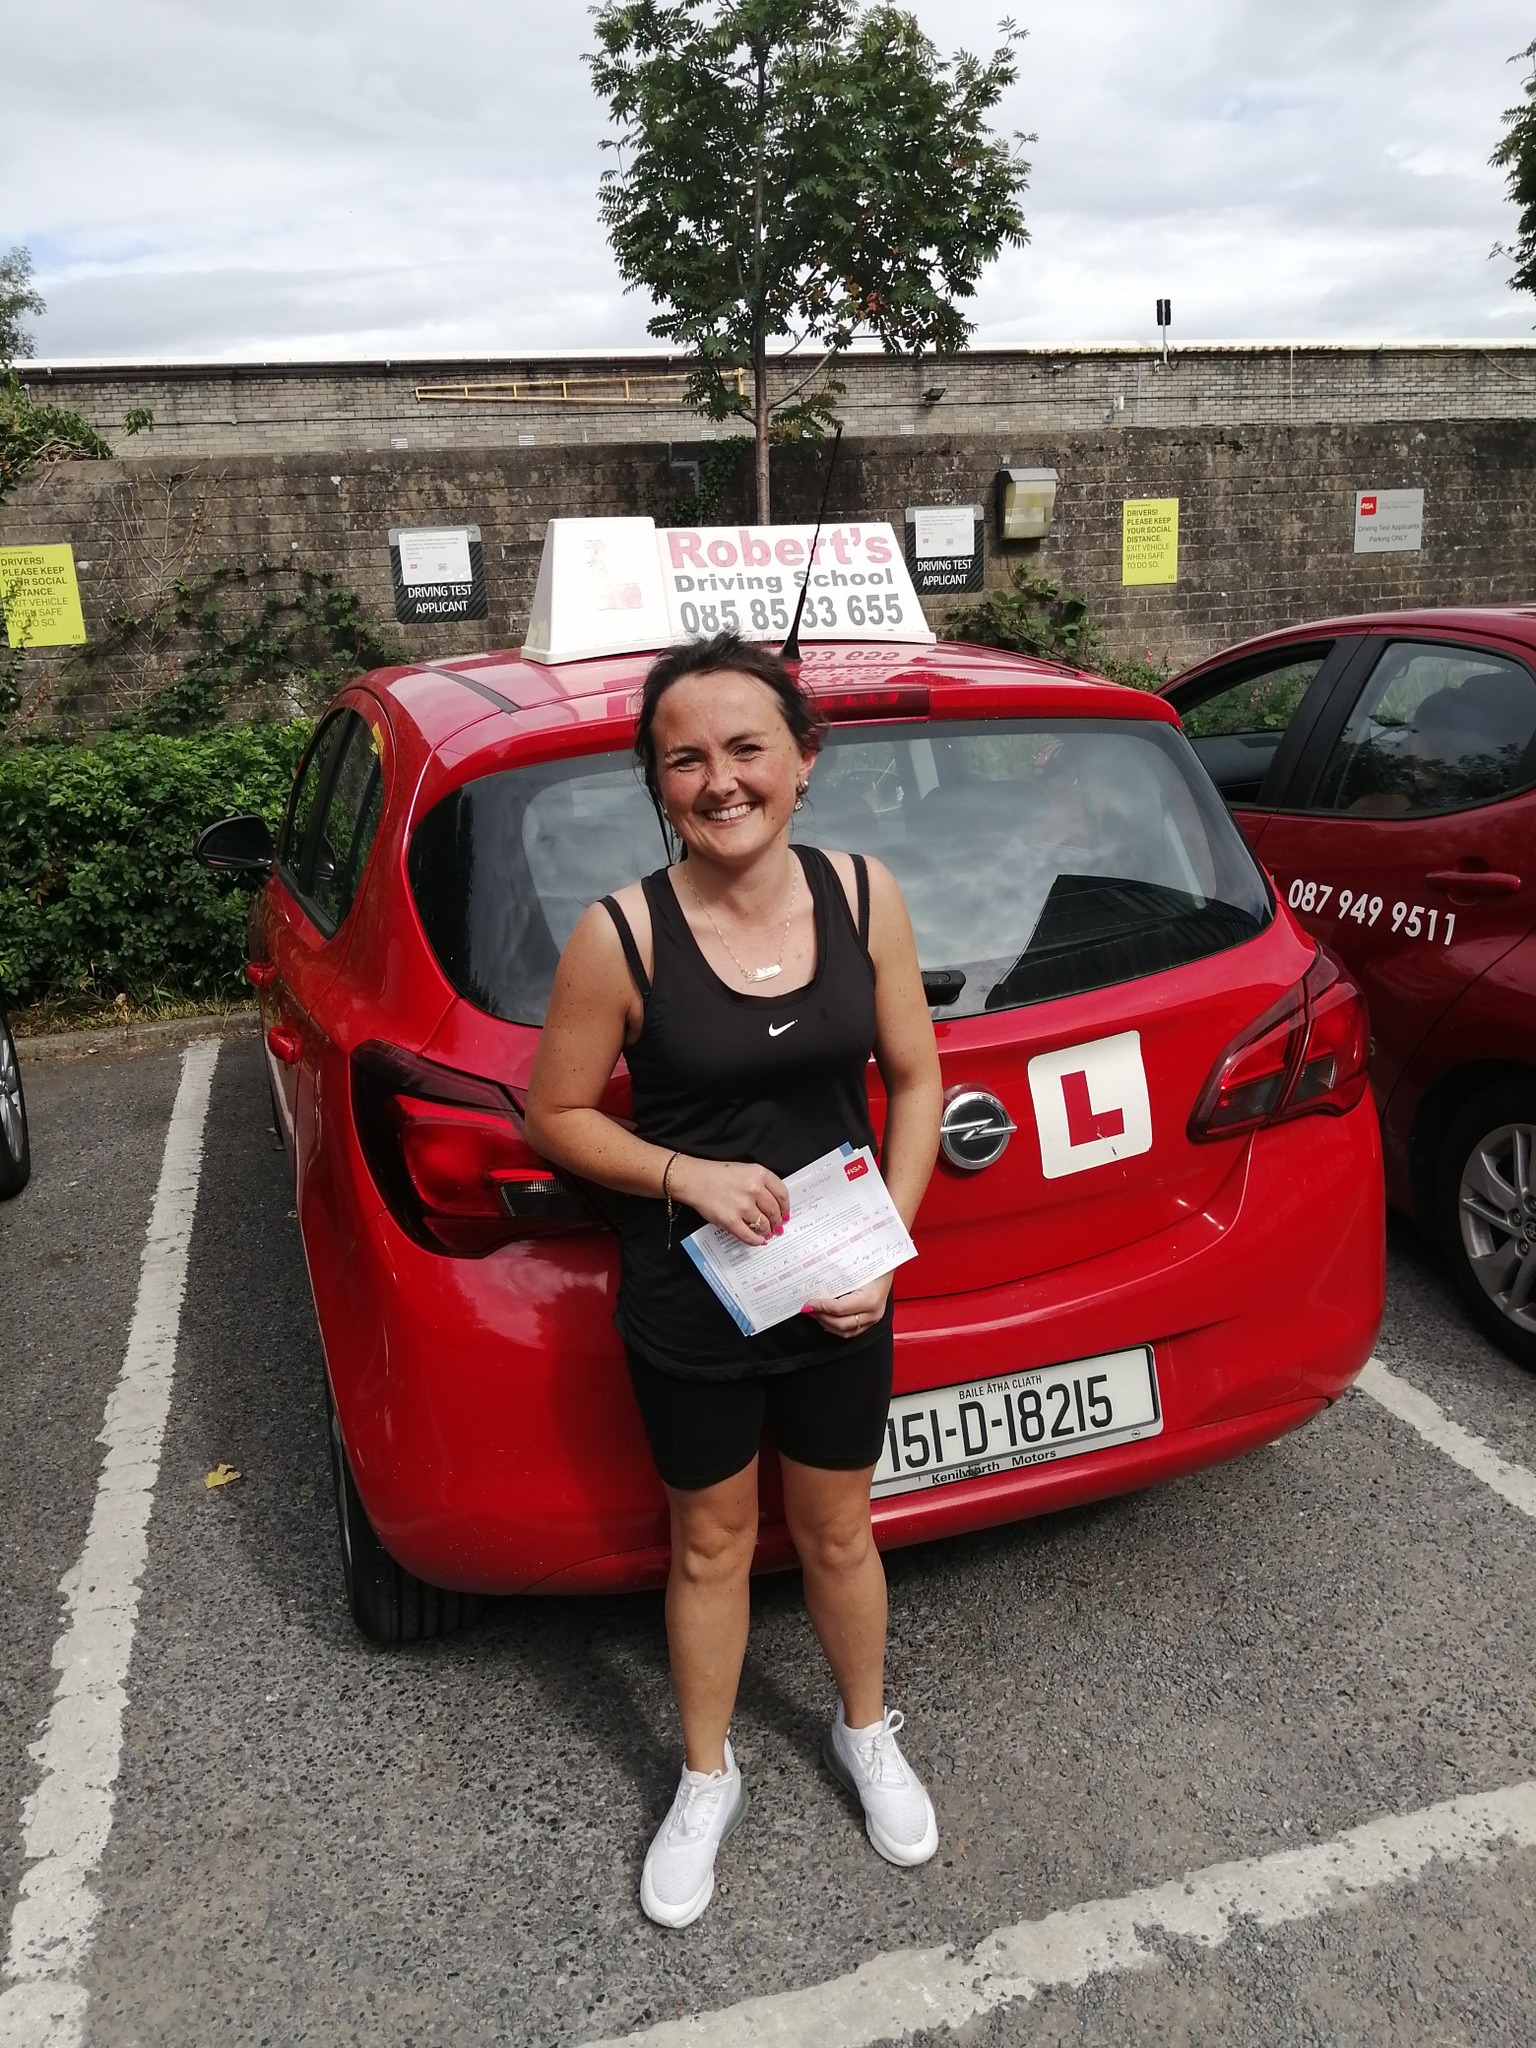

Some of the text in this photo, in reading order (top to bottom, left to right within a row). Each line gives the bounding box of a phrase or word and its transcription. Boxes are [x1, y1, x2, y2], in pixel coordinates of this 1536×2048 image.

[1127, 509, 1158, 517] DRIVERS!
[1127, 518, 1153, 526] PLEASE
[1147, 526, 1172, 534] SOCIAL
[667, 528, 892, 569] Robert's
[1127, 543, 1170, 552] EXIT VEHICLE
[1, 557, 44, 566] DRIVERS!
[918, 559, 972, 572] DRIVING TEST
[2, 566, 64, 576] PLEASE KEEP
[32, 577, 67, 586] SOCIAL
[674, 568, 893, 593] Driving School
[922, 574, 967, 586] APPLICANT
[6, 588, 55, 597] DSTANCE.
[407, 585, 472, 598] DRIVING TEST
[11, 597, 68, 607] XIT VEHICLE
[415, 601, 468, 614] APPLICANT
[39, 608, 62, 617] SAFE
[680, 593, 903, 633] 085 85 33 655
[11, 620, 23, 628] TO
[1288, 879, 1456, 946] 087 949 9511
[1060, 1070, 1125, 1147] L
[959, 1375, 1042, 1400] BAILE ÁTHA CLIATH
[887, 1374, 1113, 1472] 151-D-18215
[1012, 1450, 1057, 1467] Motors
